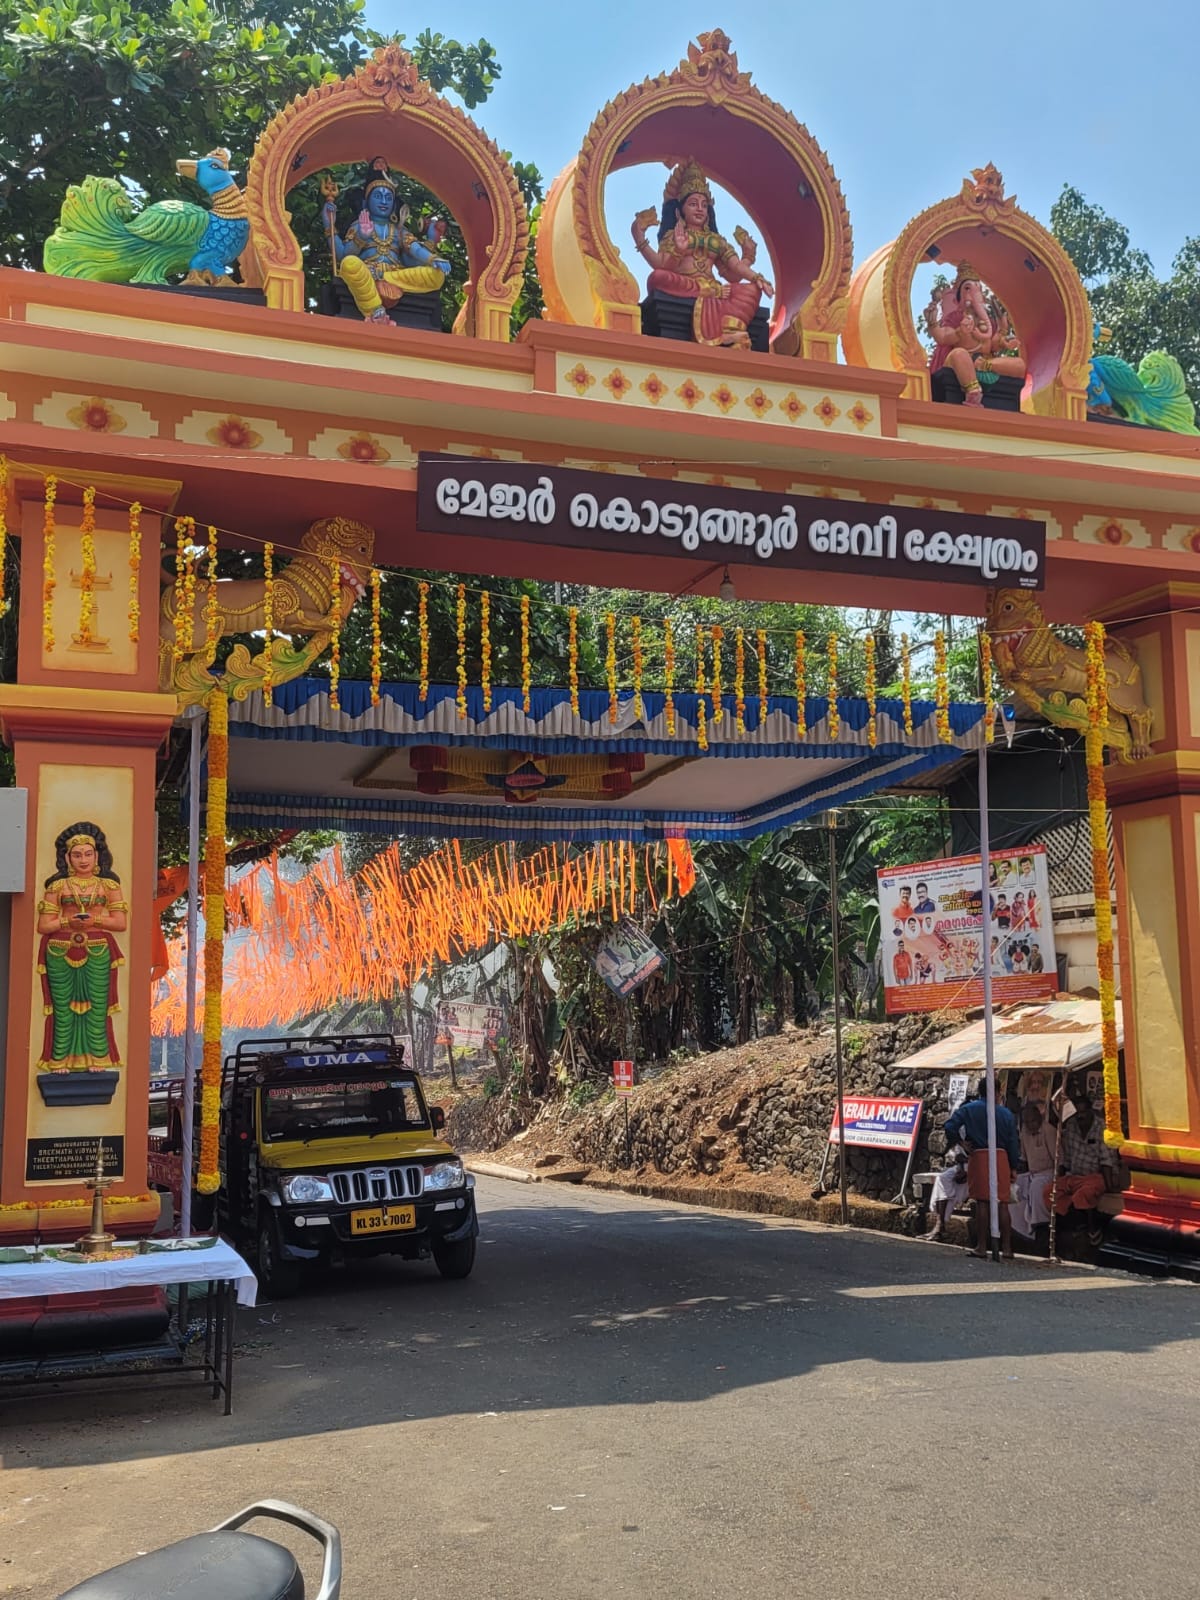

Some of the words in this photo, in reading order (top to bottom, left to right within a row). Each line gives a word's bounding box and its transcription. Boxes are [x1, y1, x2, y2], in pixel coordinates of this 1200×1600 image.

[436, 477, 555, 524] മേജർ
[569, 493, 798, 559] കൊടുങ്ങൂർ
[808, 515, 898, 559] ദേവീ
[903, 528, 1039, 579] ക്ഷേത്രം
[301, 1052, 373, 1067] UMA
[876, 1105, 915, 1123] POLICE
[38, 1148, 73, 1156] SREEMATH
[74, 1147, 114, 1155] VIDYANNDA
[356, 1218, 368, 1229] KL
[369, 1217, 381, 1228] 33
[390, 1213, 411, 1225] 7002
